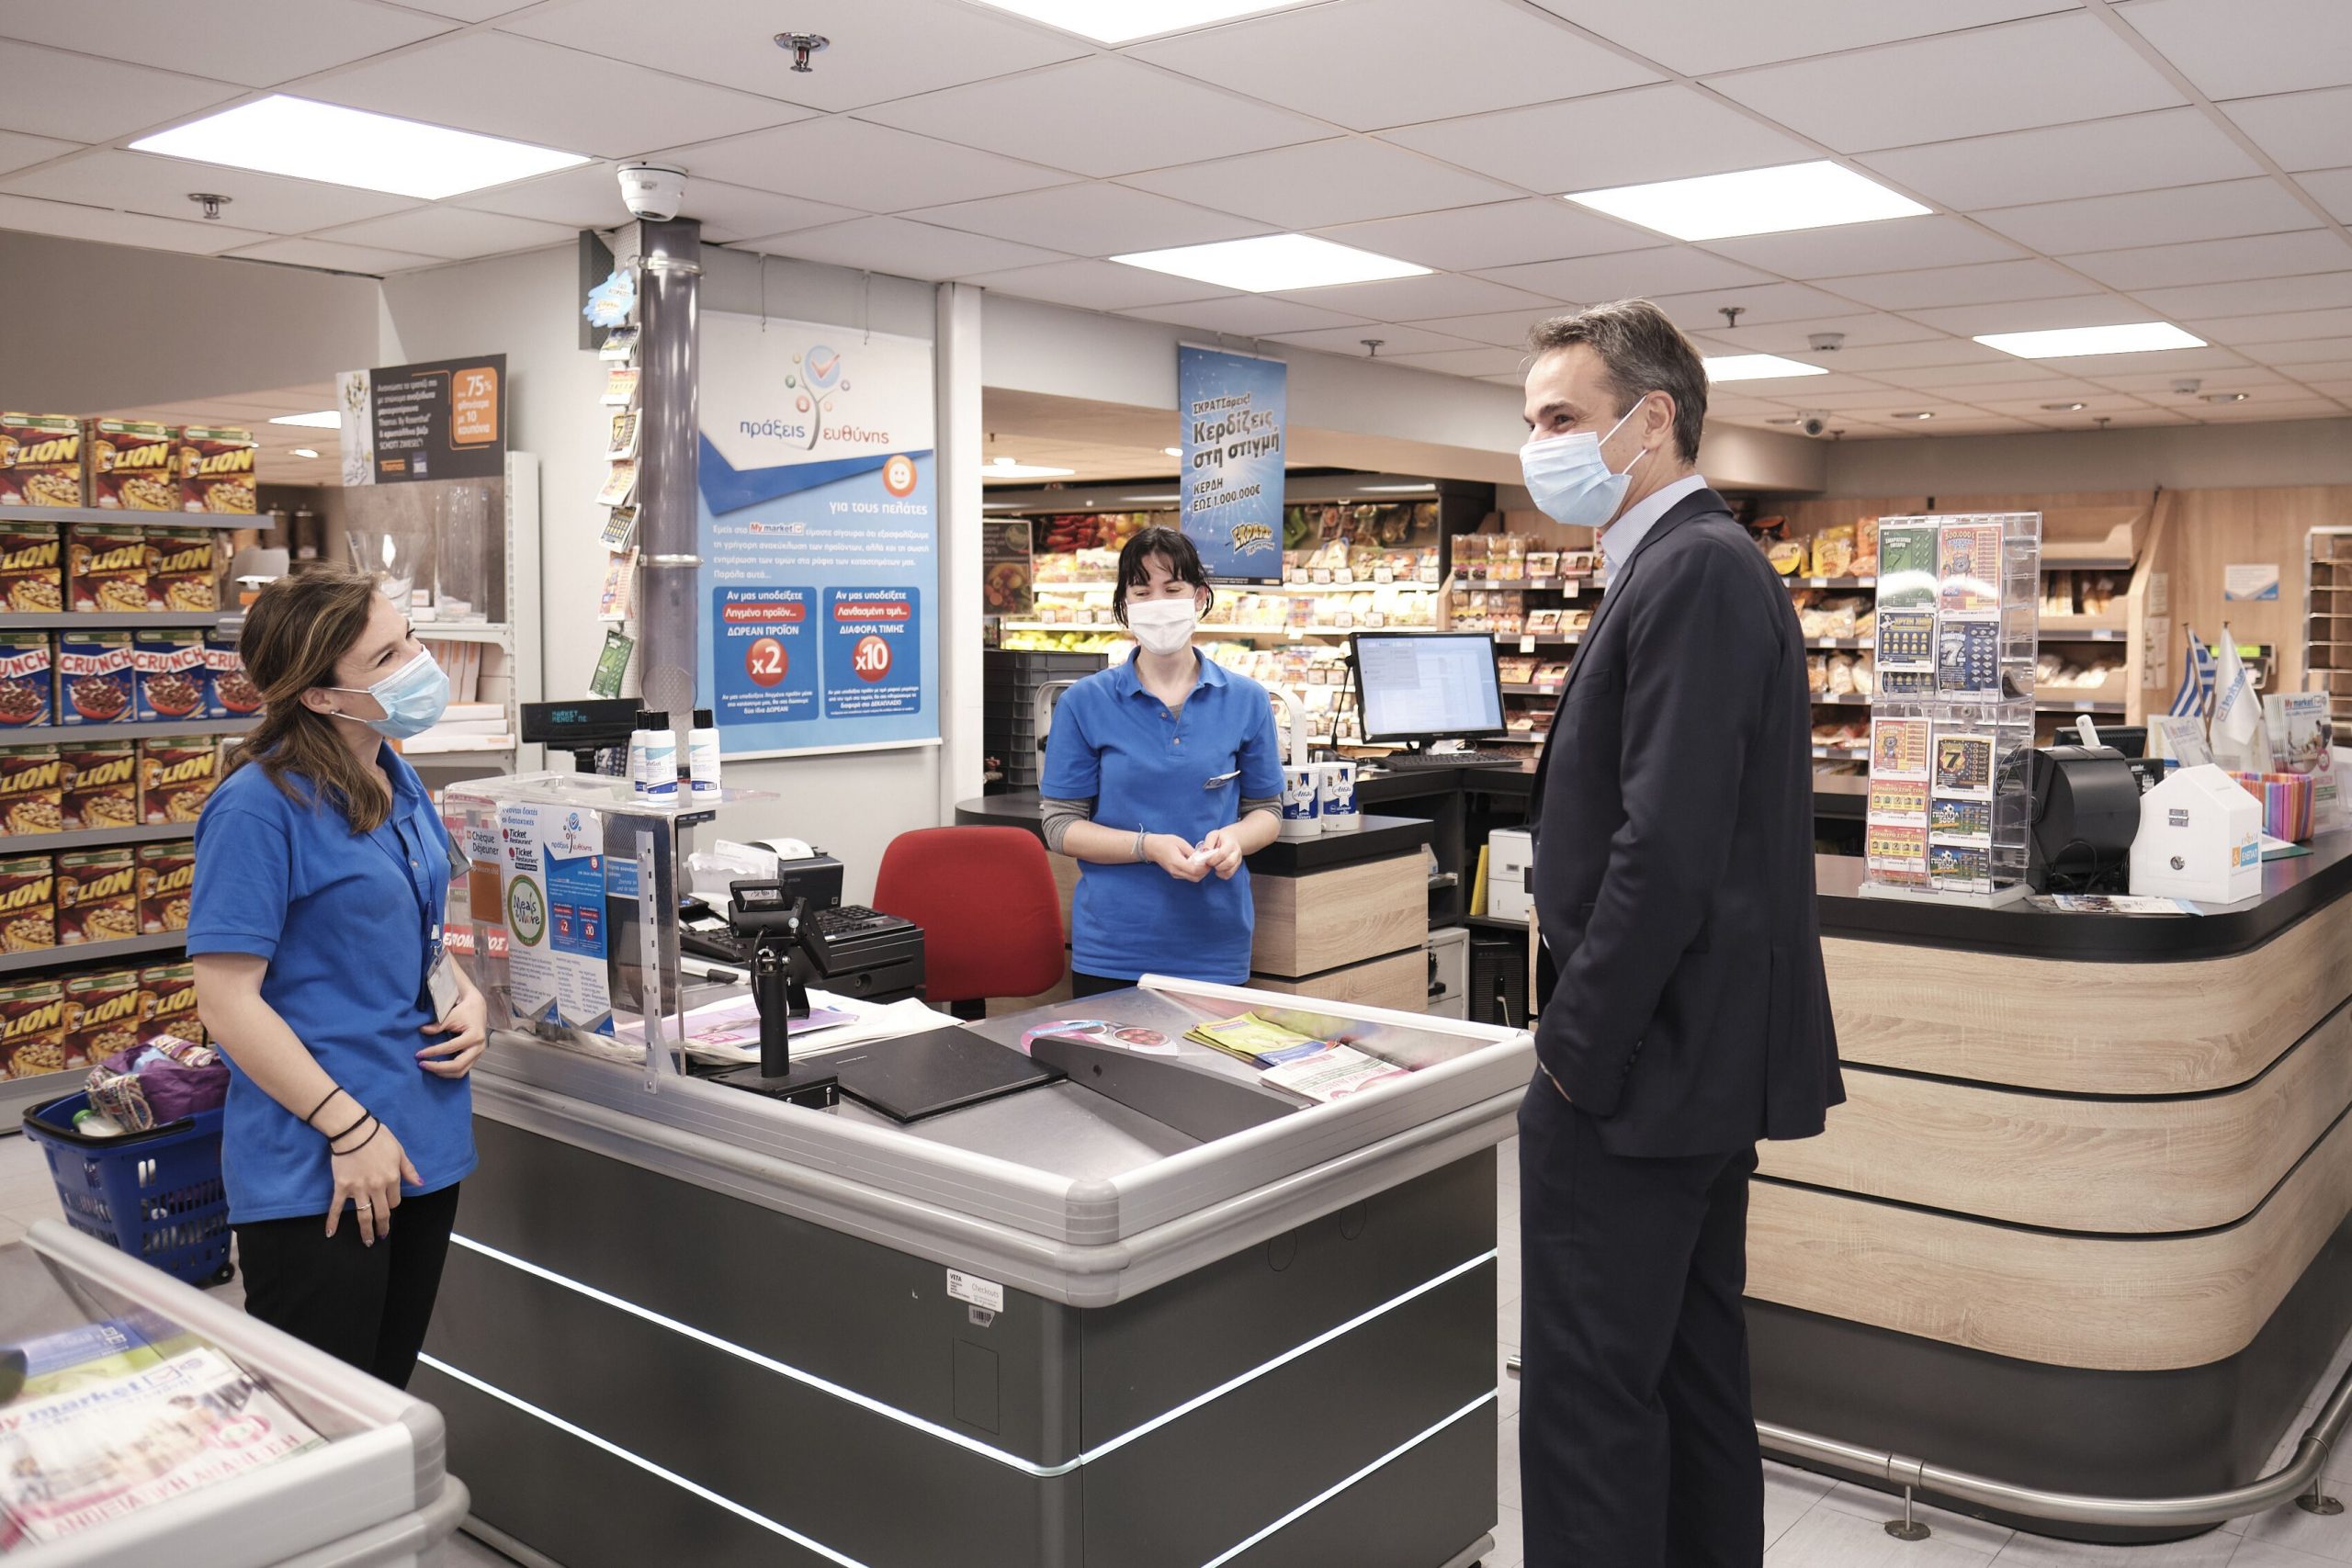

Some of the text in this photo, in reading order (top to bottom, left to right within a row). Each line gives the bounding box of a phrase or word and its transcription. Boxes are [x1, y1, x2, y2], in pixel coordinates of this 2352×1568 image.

[1193, 393, 1250, 414] ΣΚΡΑΤΣάρεις!
[467, 411, 477, 423] 10
[1193, 410, 1272, 445] Κερδίζεις
[740, 419, 805, 439] πράξεις
[823, 424, 889, 444] ευθύνης
[17, 435, 81, 463] LION
[113, 442, 169, 468] LION
[1193, 426, 1280, 468] στη στιγμή
[198, 447, 255, 473] LION
[1193, 478, 1223, 495] ΚΕΡΔΗ
[829, 501, 928, 515] για τους πελάτες
[1193, 484, 1261, 512] ΕΩΣ 1.000.000€
[750, 523, 763, 533] My
[763, 524, 793, 533] market
[2, 541, 60, 570] LION
[90, 541, 146, 570] LION
[161, 546, 213, 571] LION
[727, 591, 803, 602] Αν μας υποδείξετε
[835, 590, 907, 602] Αν μας υποδείξετε
[725, 607, 797, 619] Ληγμένο προϊόν...
[837, 606, 885, 617] Λανθασμένη
[727, 624, 799, 637] ΔΩΡΕΑΝ ΠΡΟΪΟΝ
[839, 625, 904, 635] ΔΙΑΦΟΡΑ ΤΙΜΗΣ
[0, 649, 50, 678] UNCH
[61, 647, 134, 674] CRUNCH
[135, 645, 206, 670] CRUNCH
[206, 651, 240, 668] CRU
[752, 646, 783, 674] x2
[854, 642, 888, 671] x10
[2293, 698, 2313, 708] market
[162, 752, 215, 783] LION
[1945, 751, 1961, 769] 7
[0, 761, 61, 793] LION
[76, 757, 135, 788] LION
[471, 830, 495, 845] Chèque
[509, 829, 527, 839] Ticket
[472, 842, 499, 856] Déjeuner
[515, 847, 533, 857] Ticket
[77, 866, 135, 901] LION
[157, 863, 195, 892] LIO
[0, 875, 53, 911] LION
[514, 893, 537, 915] Meals
[519, 910, 540, 925] More
[443, 931, 505, 952] ΕΠΟΜΟΣ
[83, 988, 138, 1026] LION
[4, 1000, 62, 1038] LION
[950, 1273, 962, 1282] VETA
